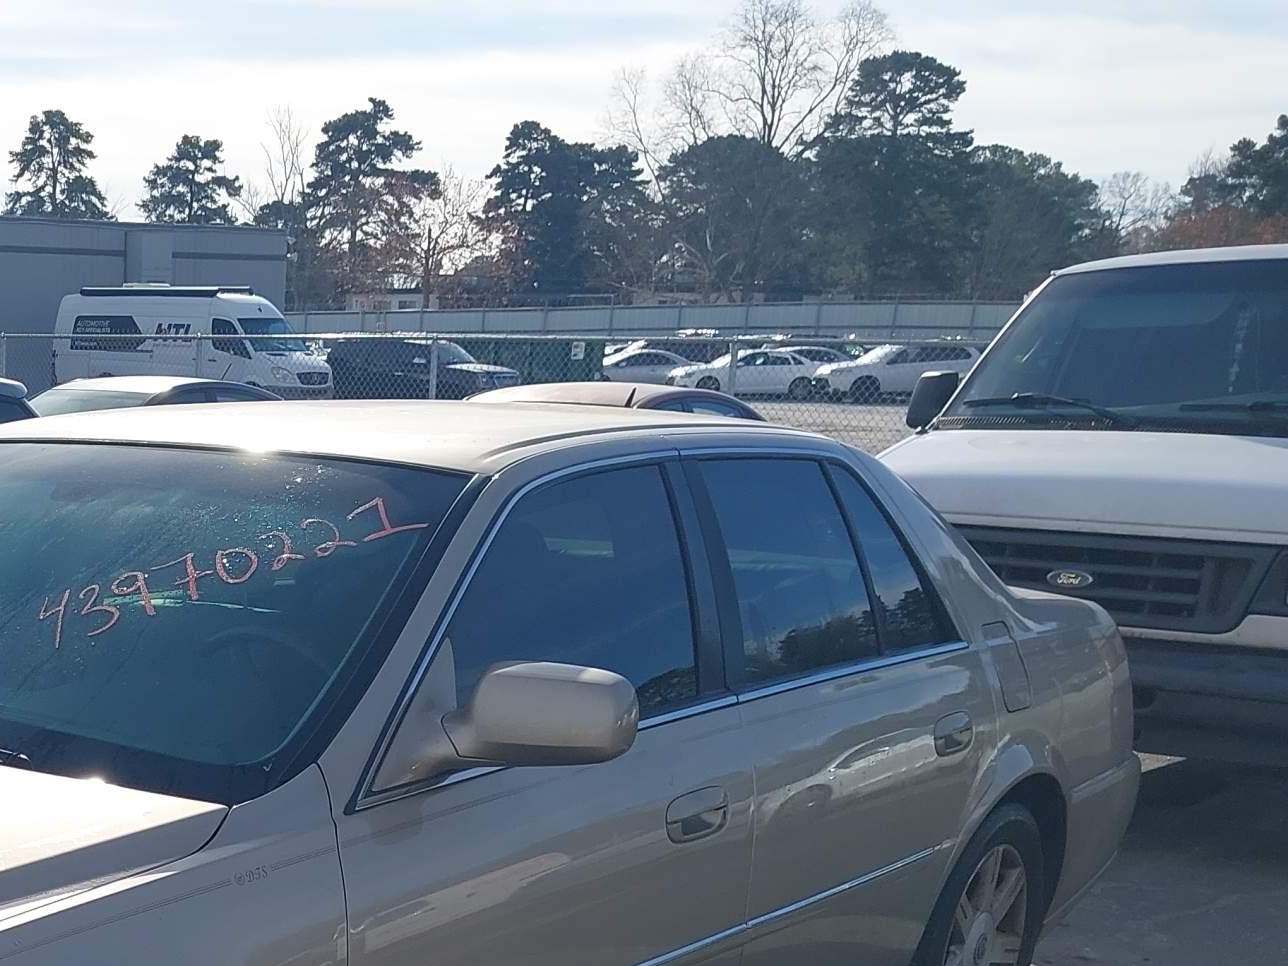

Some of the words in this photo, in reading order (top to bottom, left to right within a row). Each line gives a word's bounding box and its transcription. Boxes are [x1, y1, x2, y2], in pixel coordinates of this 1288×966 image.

[76, 320, 111, 328] AUTOMOTIVE
[38, 496, 430, 649] 43970221
[1056, 572, 1081, 585] Ford
